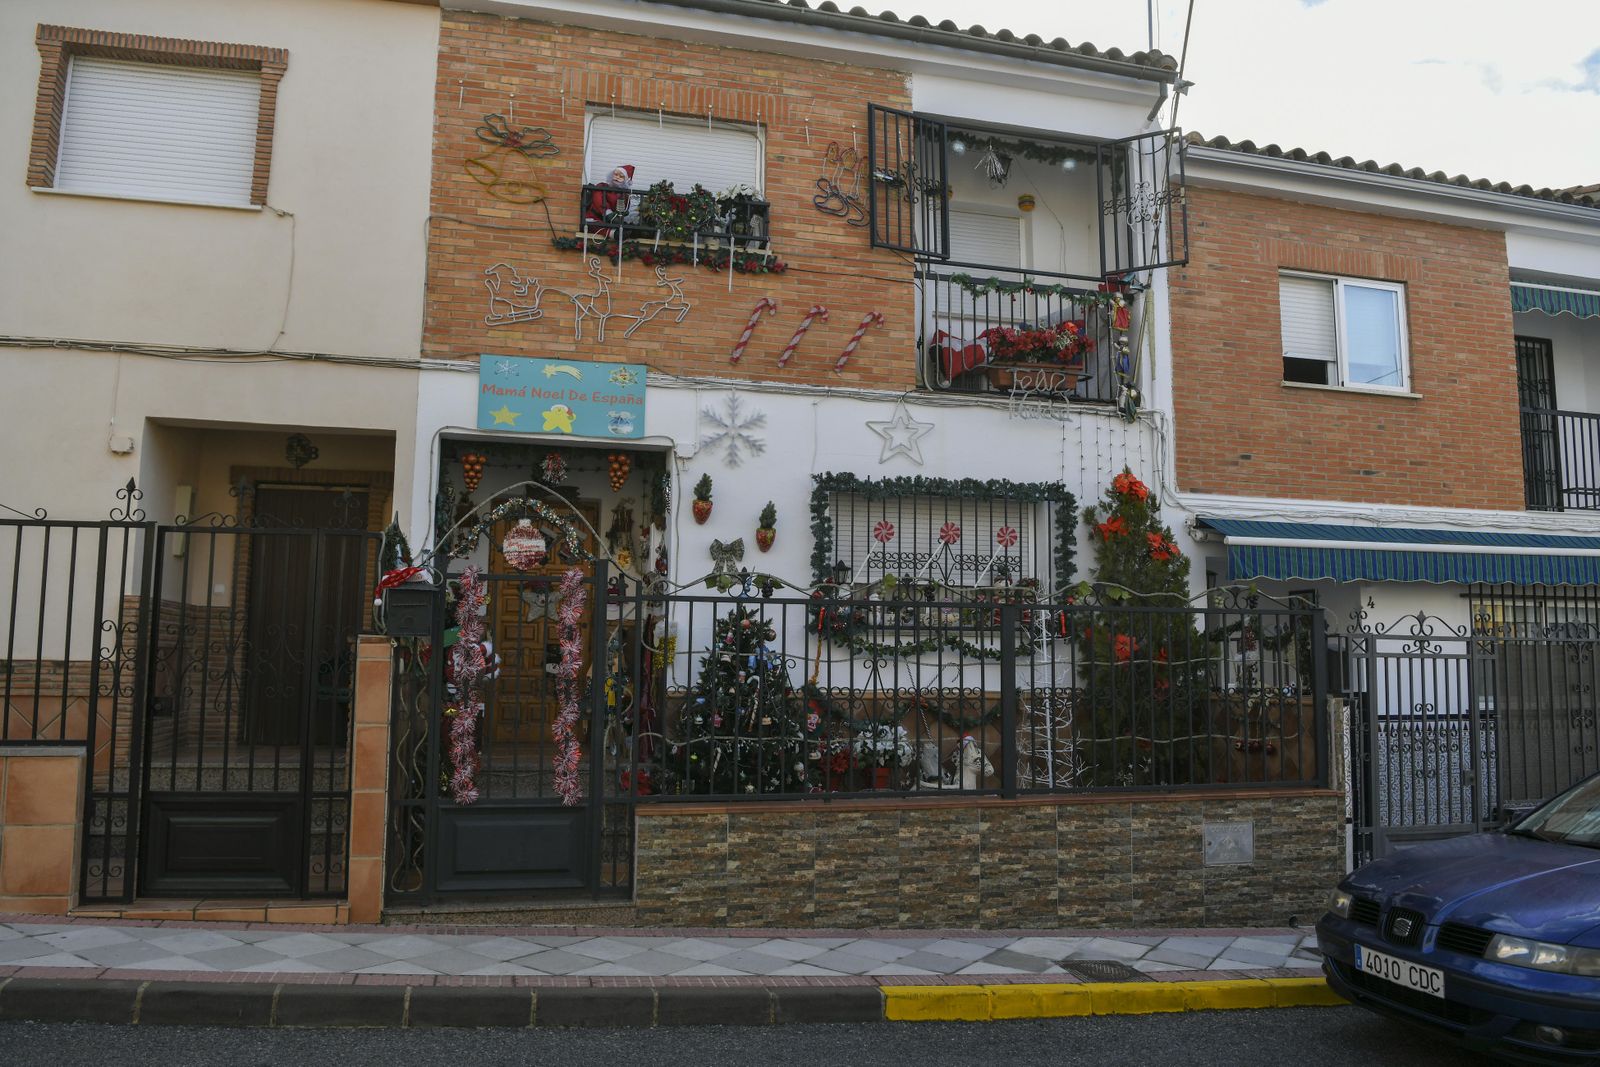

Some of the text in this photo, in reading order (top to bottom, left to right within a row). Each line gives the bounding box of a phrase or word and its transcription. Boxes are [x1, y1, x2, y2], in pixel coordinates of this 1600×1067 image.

[482, 384, 643, 405] Mamá Noel De España
[1367, 596, 1375, 609] 4
[1366, 951, 1440, 994] 4010 CDC
